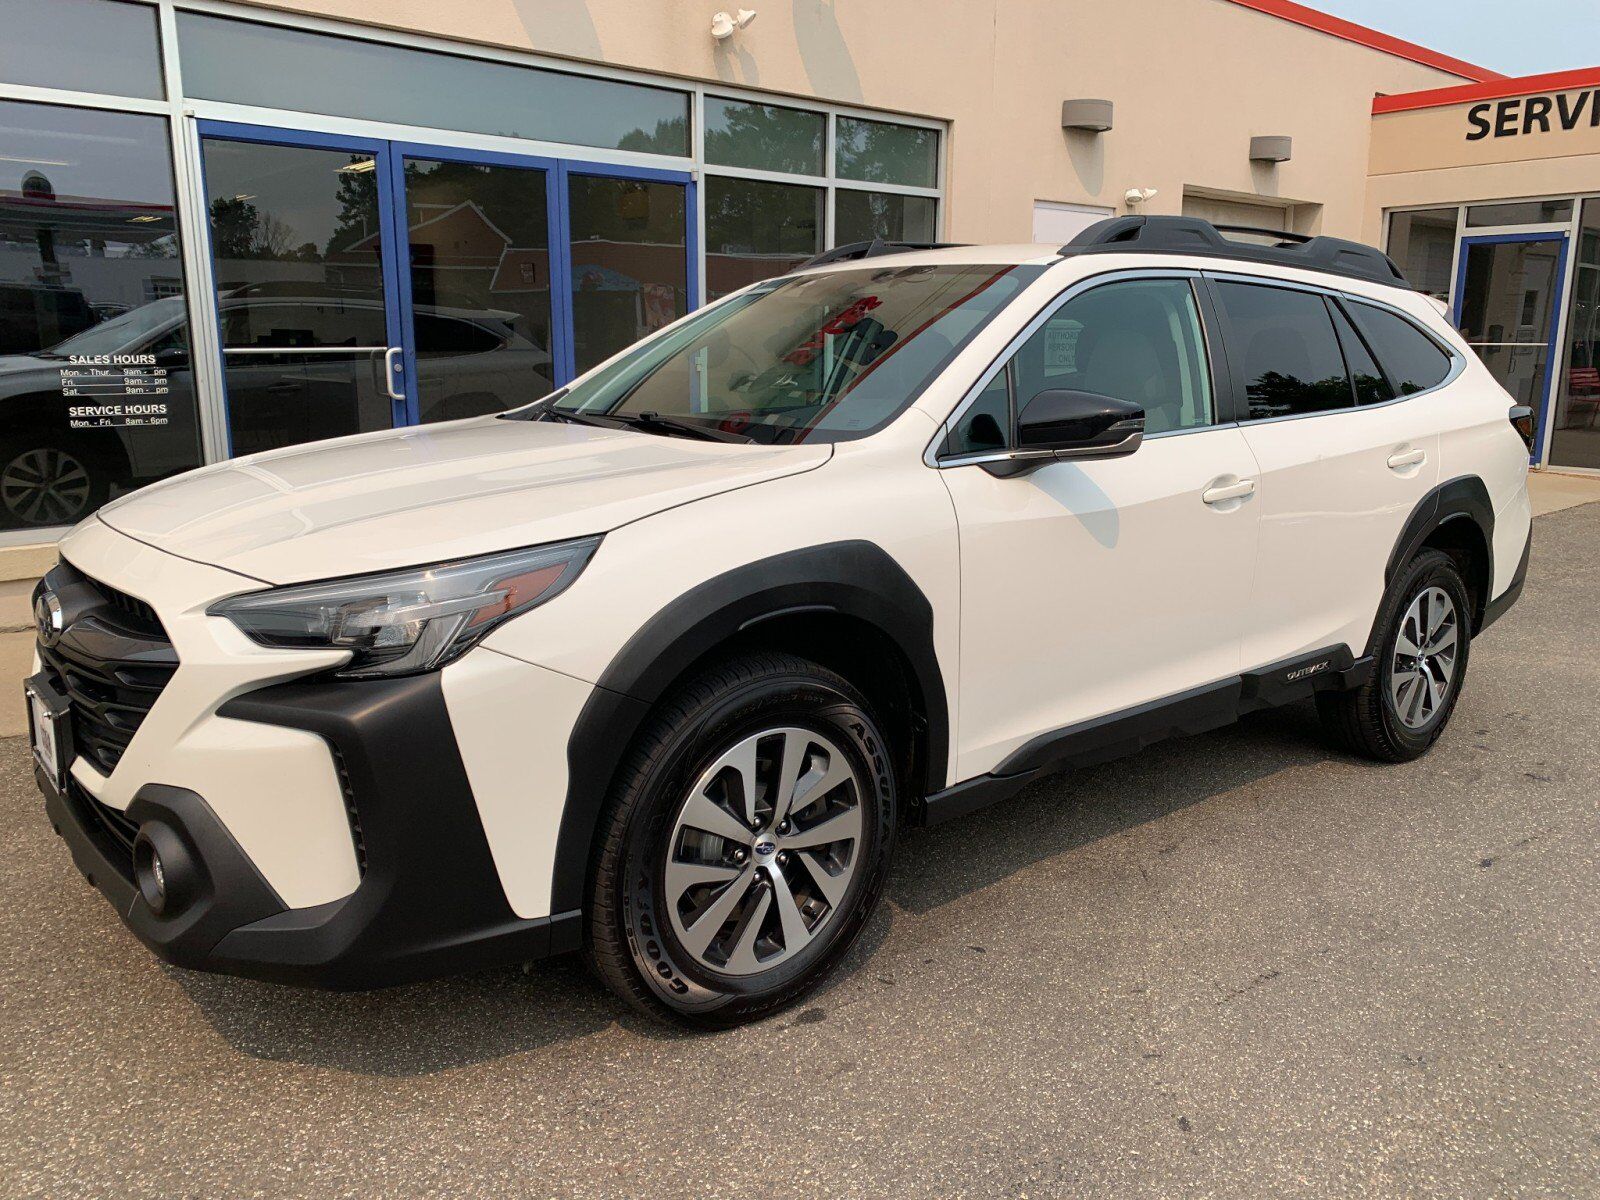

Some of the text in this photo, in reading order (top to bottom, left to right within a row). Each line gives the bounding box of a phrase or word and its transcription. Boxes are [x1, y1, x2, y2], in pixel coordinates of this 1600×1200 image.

[1465, 89, 1600, 141] SERVI
[69, 354, 156, 364] SALES HOURS
[60, 369, 82, 377] Mon.
[123, 368, 141, 376] 9am
[62, 388, 80, 396] Sat.
[69, 404, 167, 416] SERVICE HOURS
[70, 420, 92, 428] Mon.
[1286, 661, 1330, 680] OUTBACK
